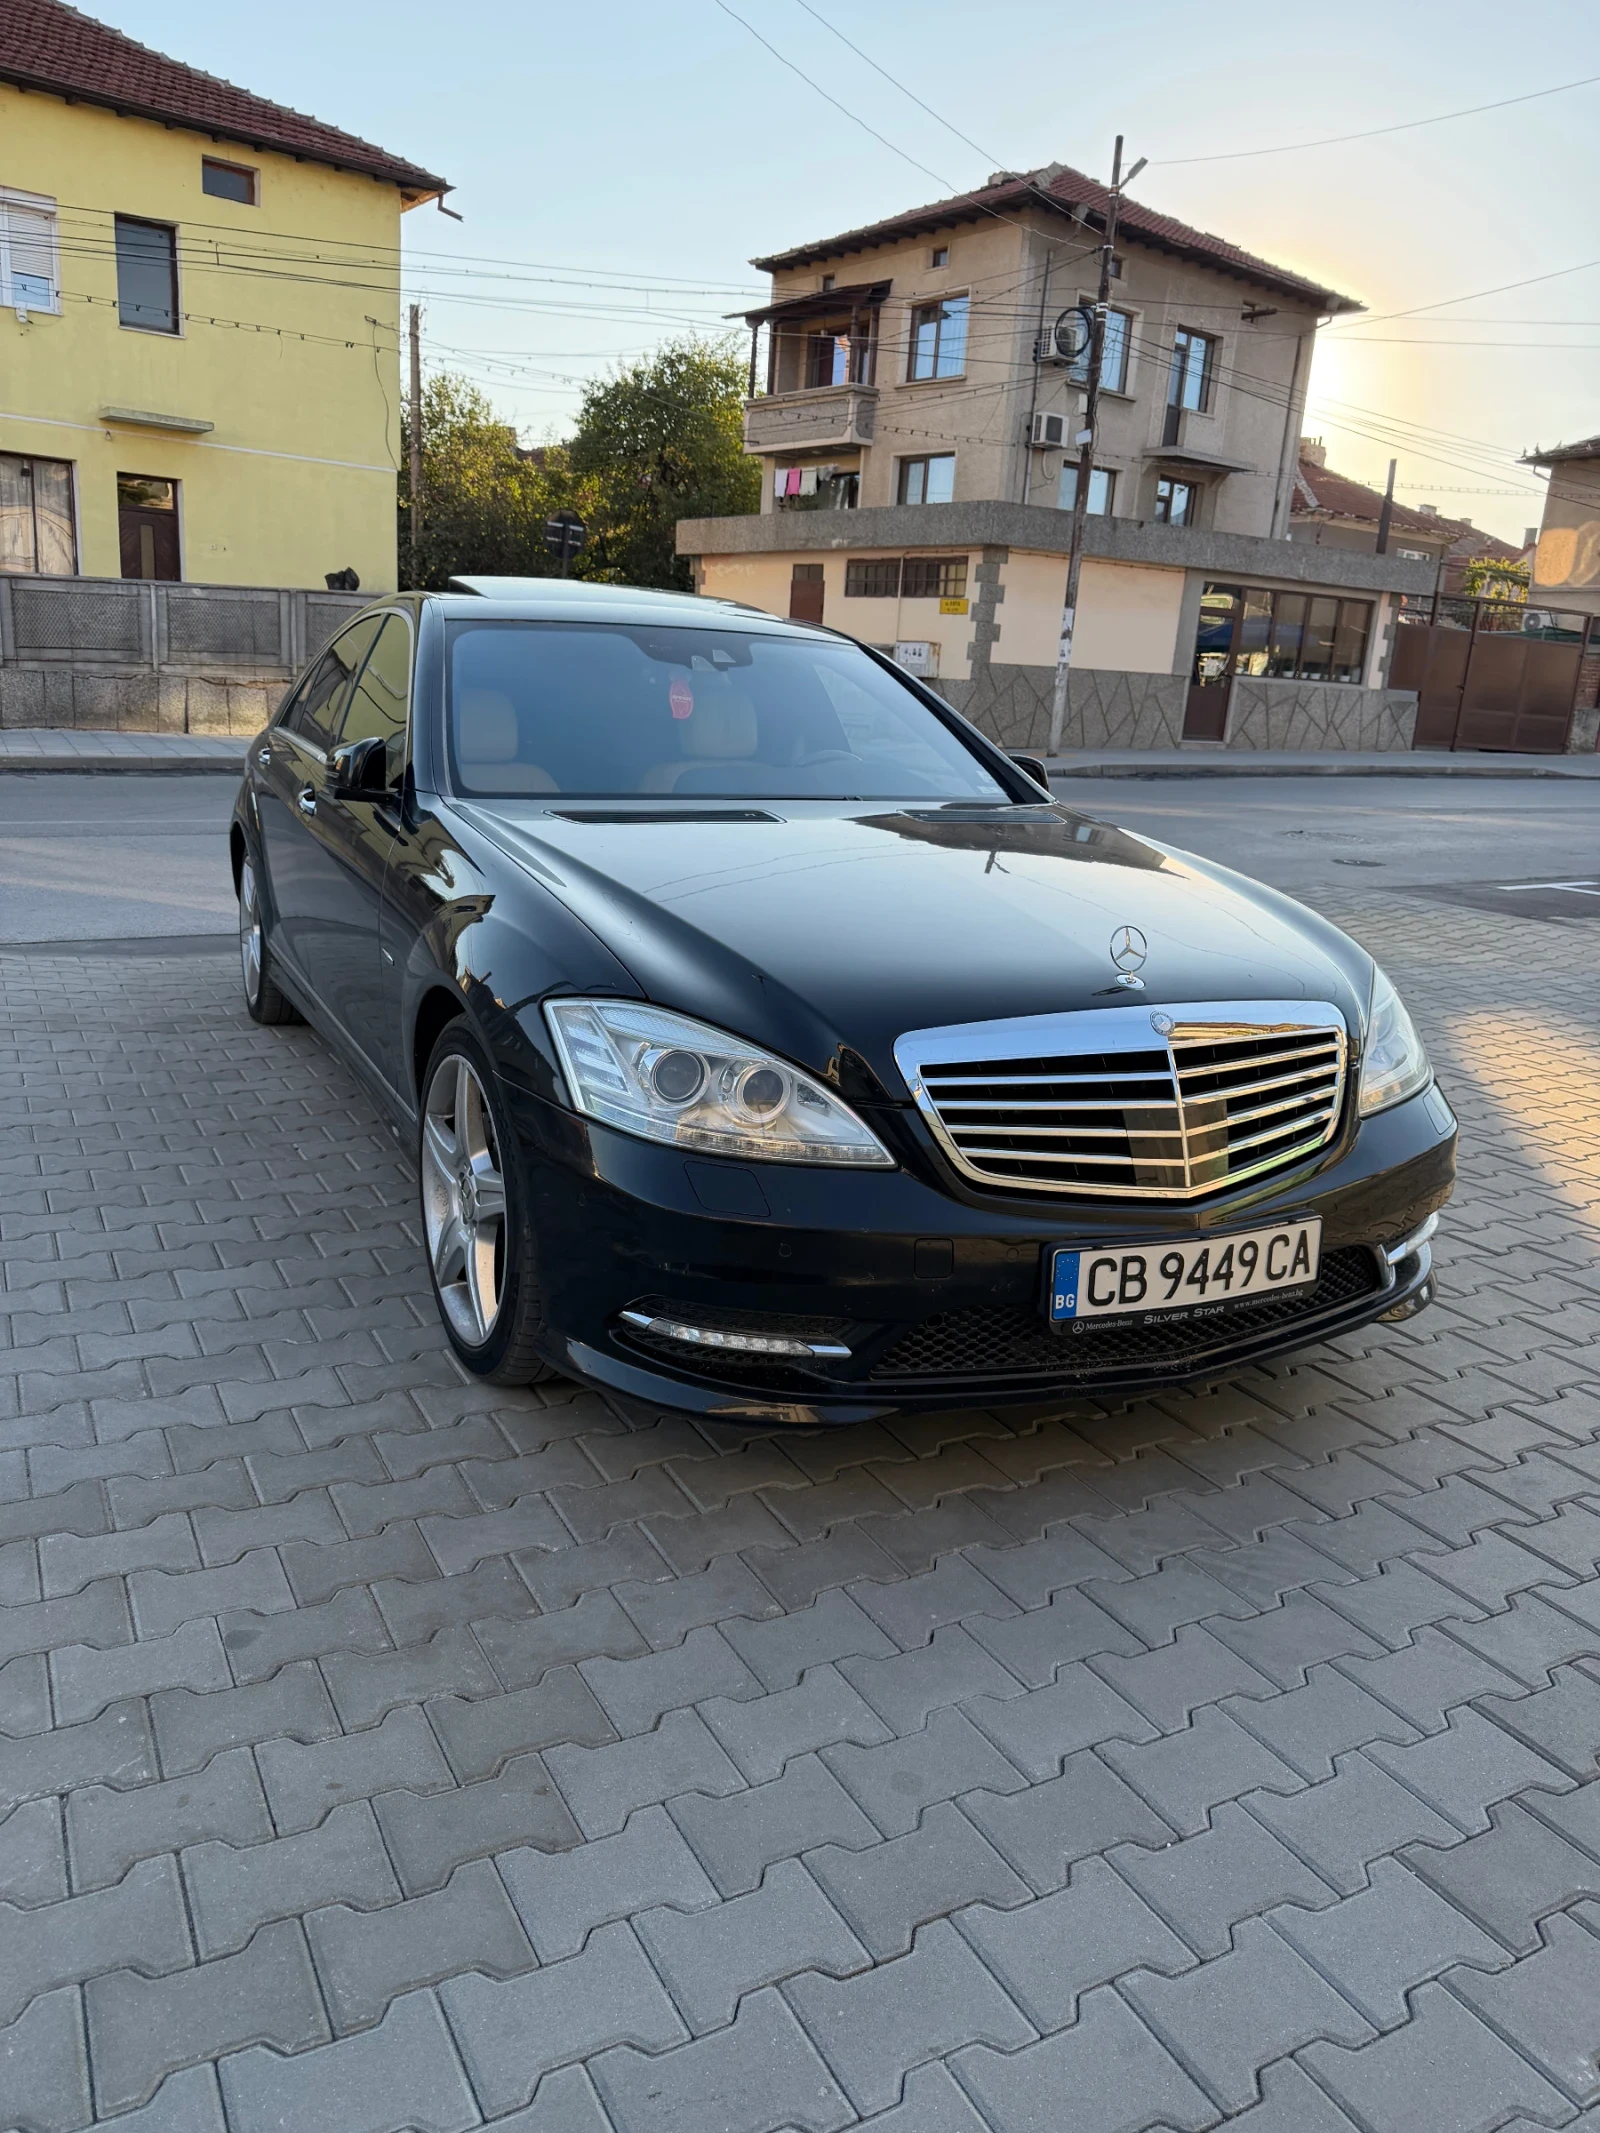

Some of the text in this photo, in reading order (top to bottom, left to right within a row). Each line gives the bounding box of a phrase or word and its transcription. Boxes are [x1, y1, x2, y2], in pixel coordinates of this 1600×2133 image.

[1087, 1229, 1310, 1307] CB 9449 CA
[1055, 1293, 1075, 1309] BG
[1143, 1305, 1225, 1325] SILVER STAR
[1085, 1318, 1134, 1331] Mercedes-Benz
